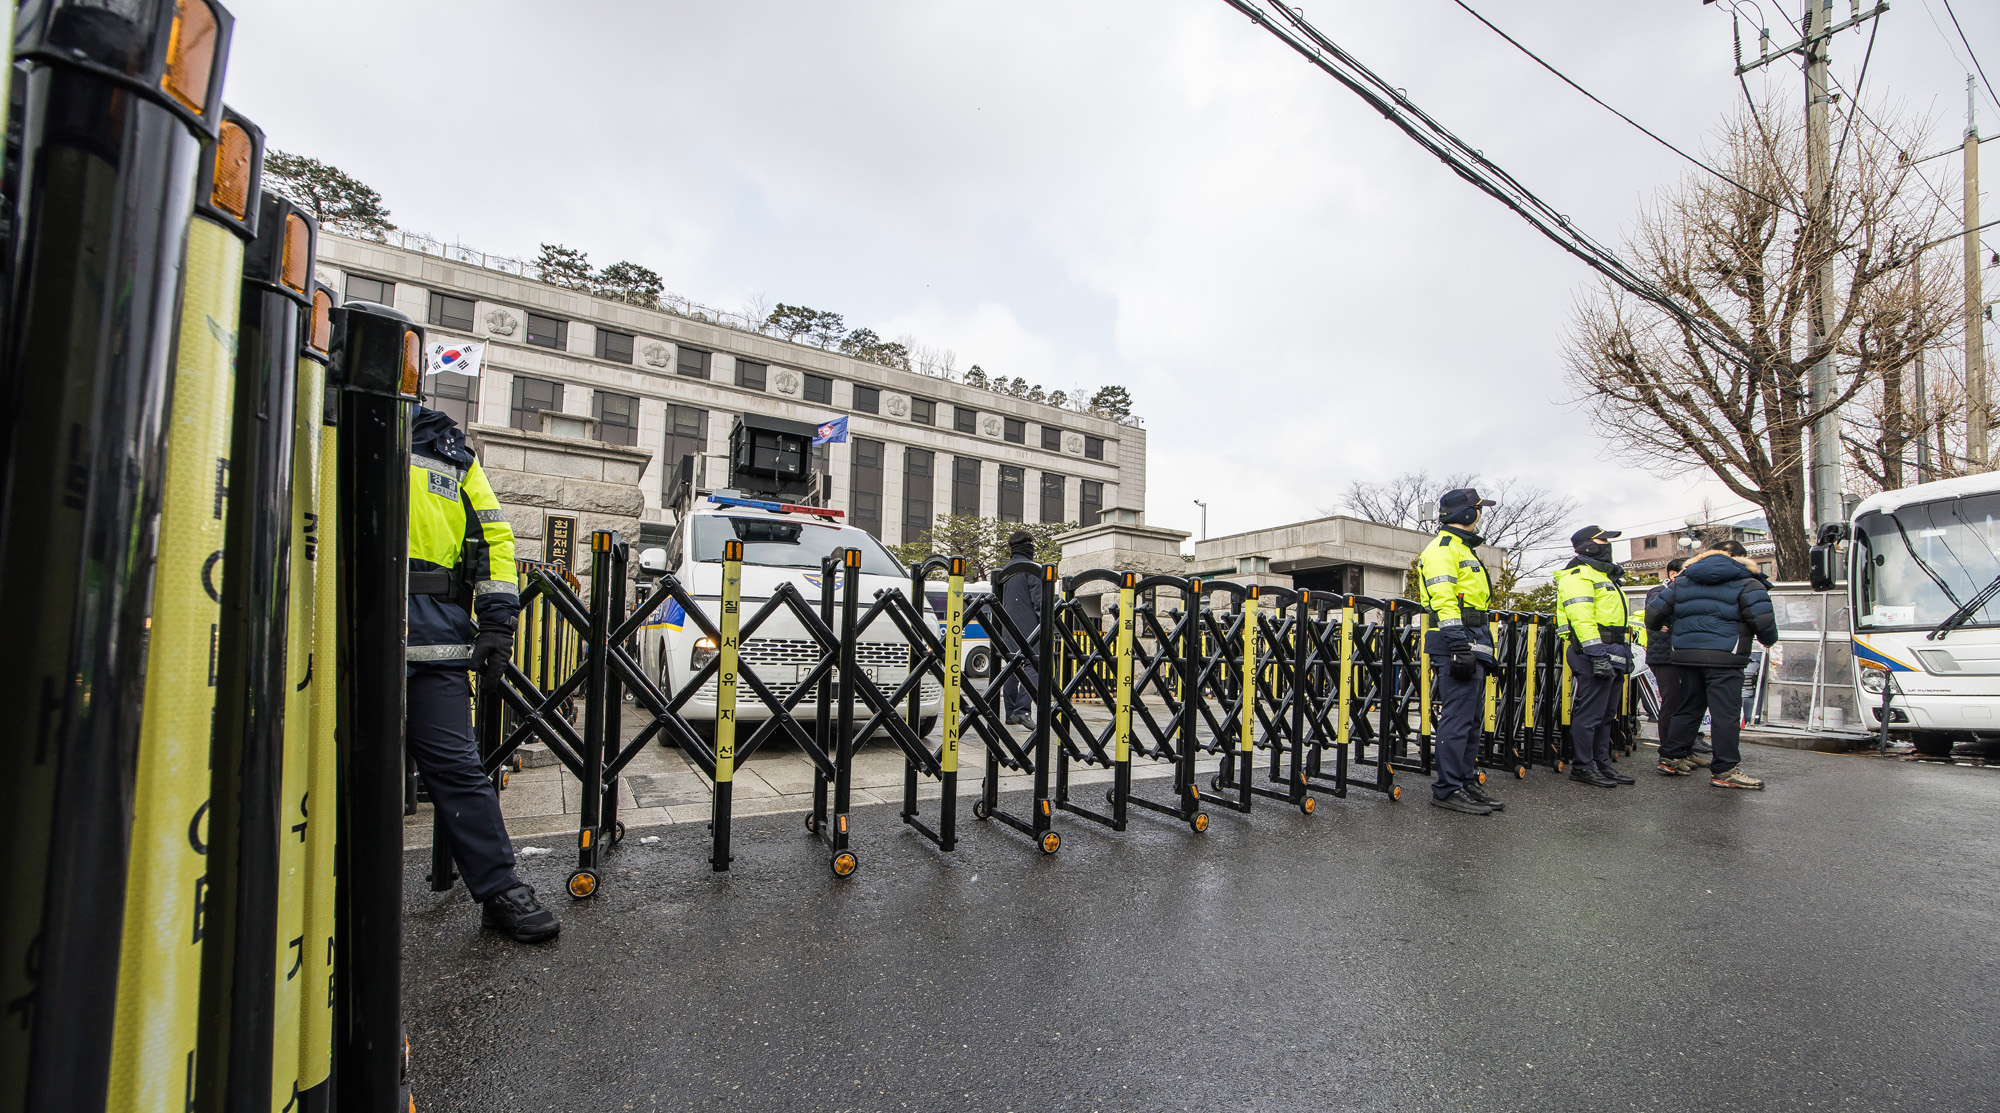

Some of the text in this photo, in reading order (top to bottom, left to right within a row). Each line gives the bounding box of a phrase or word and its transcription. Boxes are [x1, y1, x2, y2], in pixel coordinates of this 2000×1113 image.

[431, 485, 458, 499] POLICE
[718, 600, 738, 759] 질서유지선
[949, 611, 961, 752] POLICE LINE
[1121, 619, 1133, 744] 질서유지선
